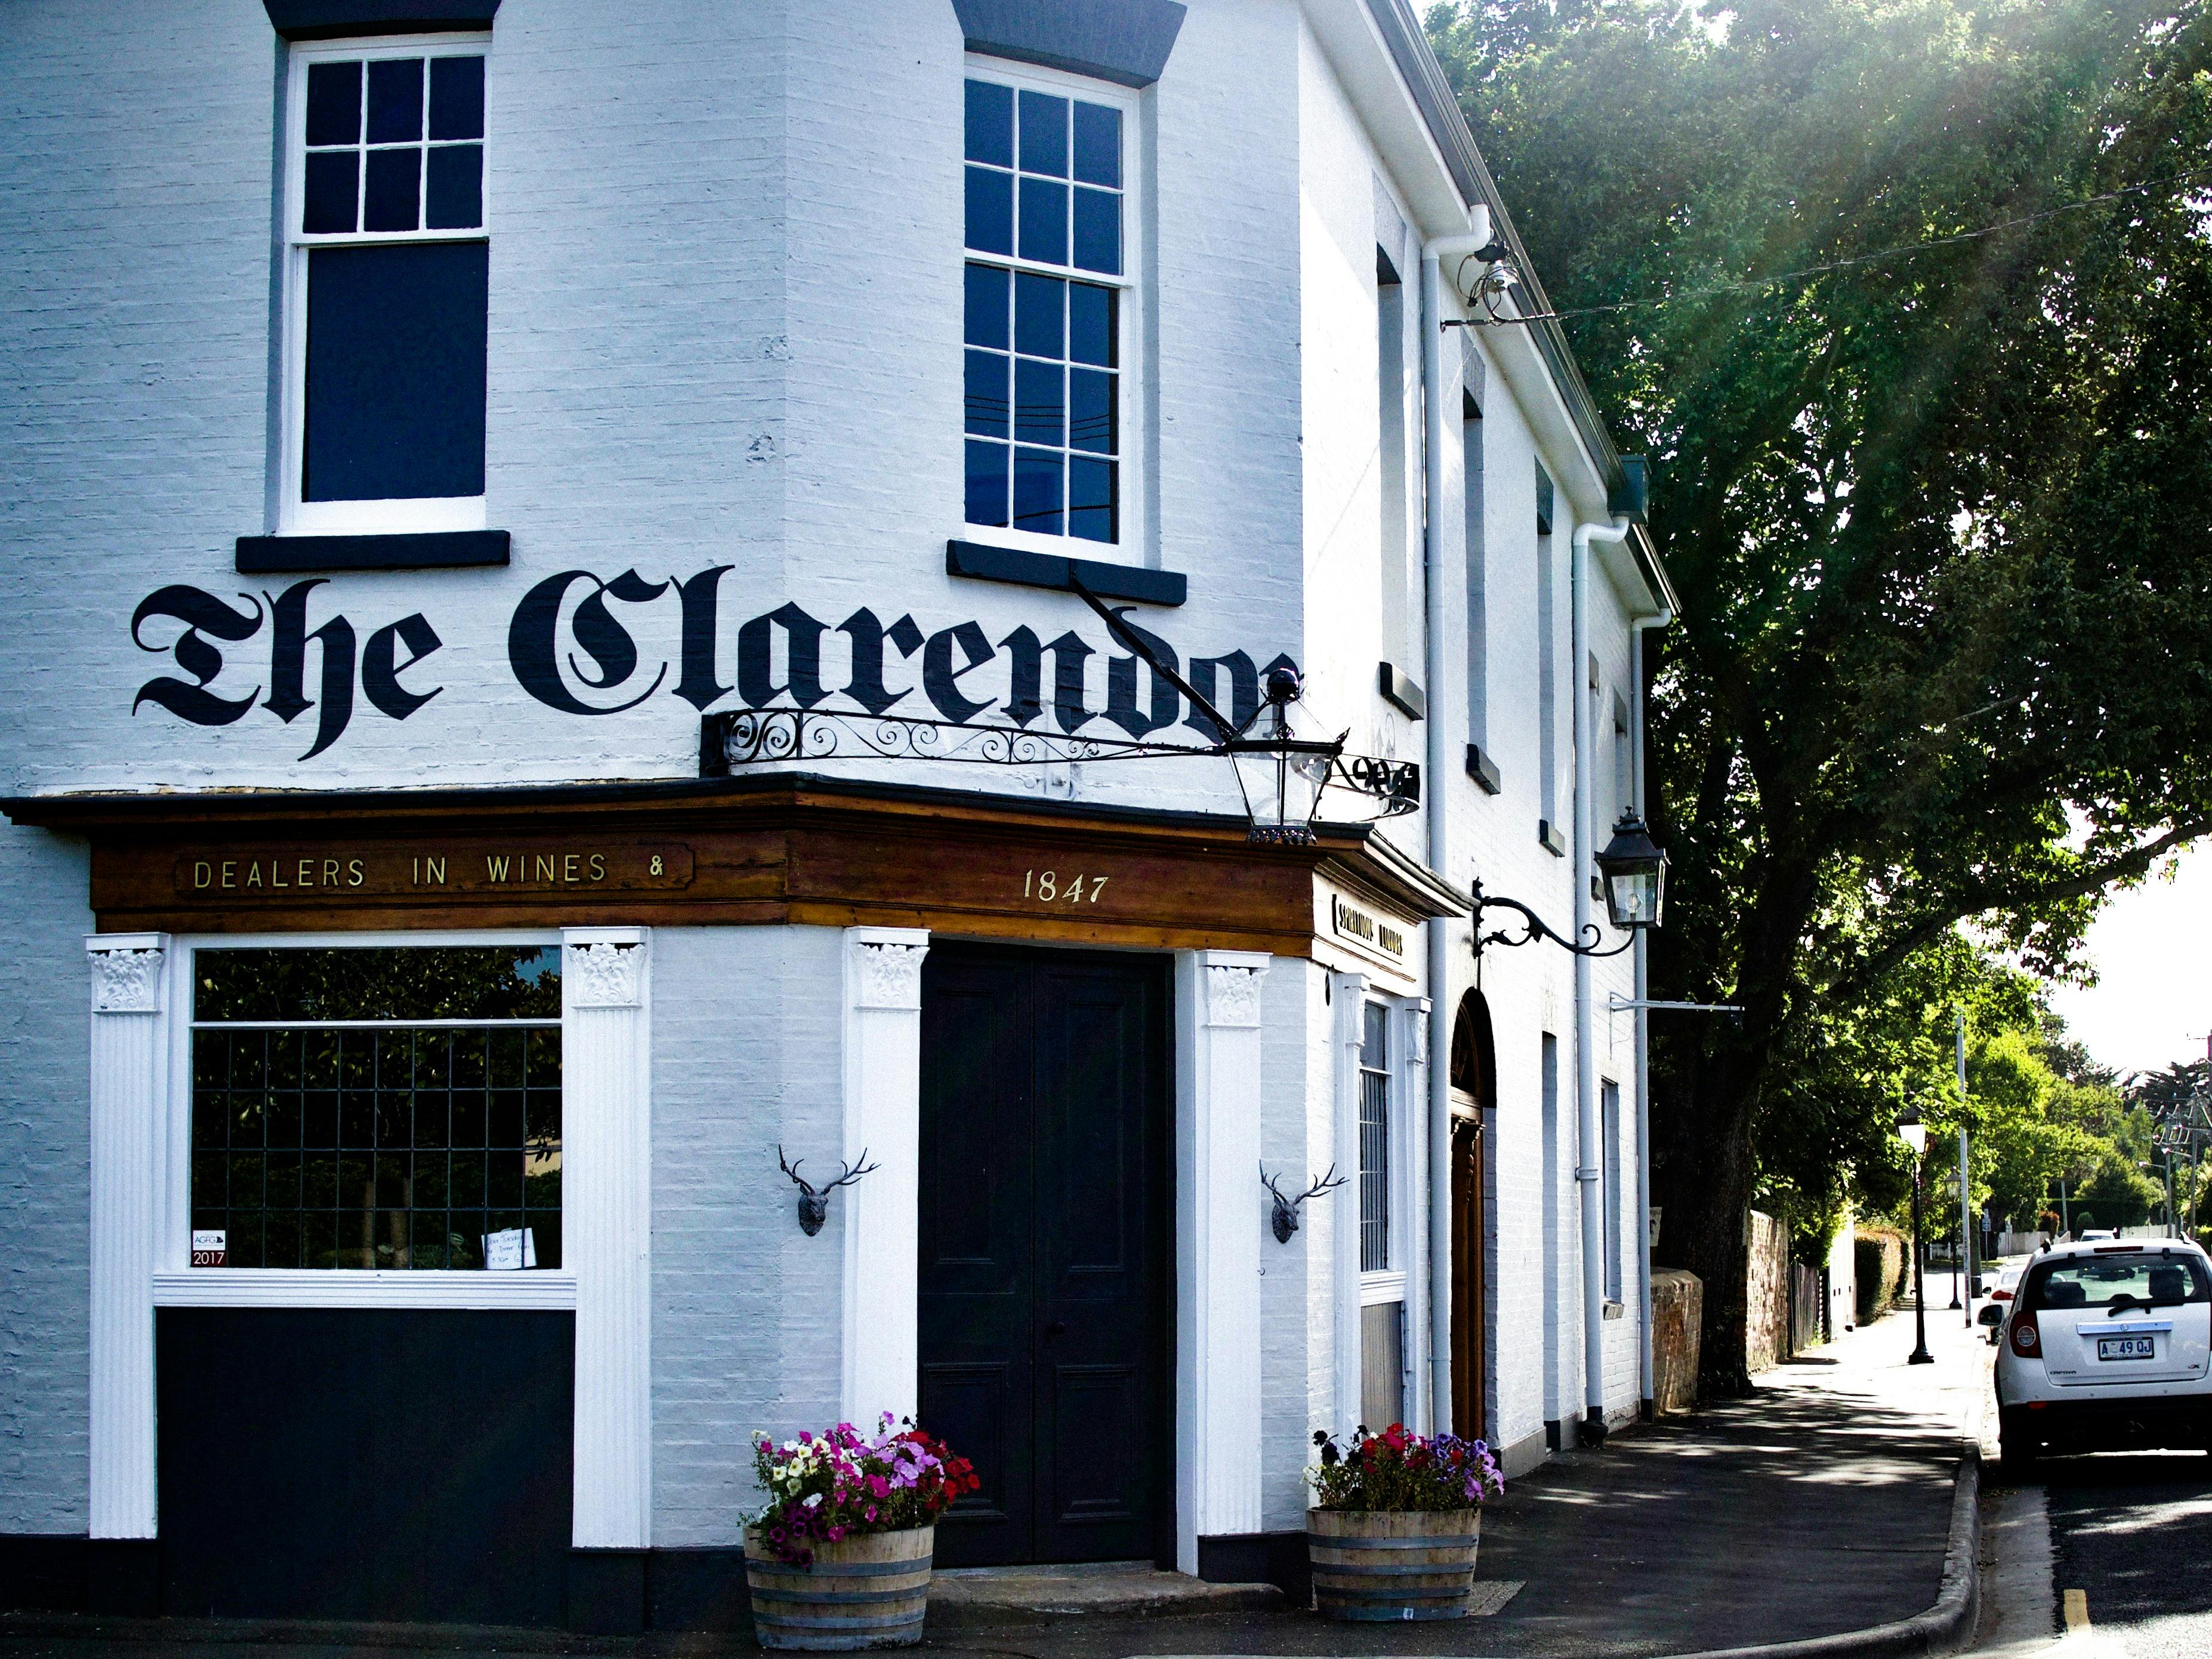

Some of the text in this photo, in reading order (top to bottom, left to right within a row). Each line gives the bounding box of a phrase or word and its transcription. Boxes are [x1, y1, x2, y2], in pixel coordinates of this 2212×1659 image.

[131, 578, 444, 762] The
[194, 854, 664, 888] DEALERS IN WINES &
[1024, 869, 1109, 903] 1847
[193, 1251, 225, 1265] 2017
[2102, 1342, 2108, 1355] A
[2120, 1342, 2133, 1353] 49
